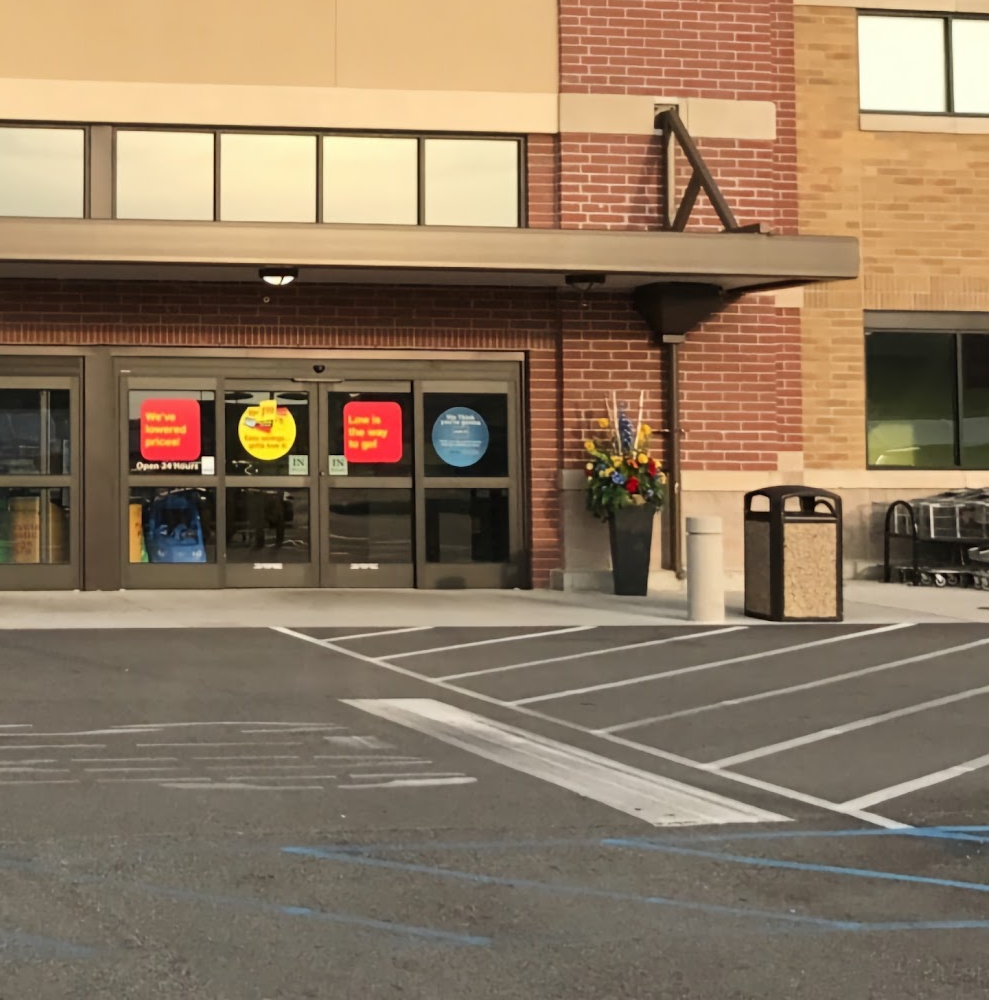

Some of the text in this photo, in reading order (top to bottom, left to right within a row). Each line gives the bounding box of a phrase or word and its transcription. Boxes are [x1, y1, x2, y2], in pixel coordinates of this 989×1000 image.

[145, 412, 176, 422] We've
[348, 414, 369, 424] Low
[145, 425, 186, 434] lowered
[348, 427, 388, 439] the way
[348, 440, 359, 448] to
[136, 461, 199, 471] Open 24 Hours
[292, 458, 305, 467] IN
[332, 458, 345, 467] IN
